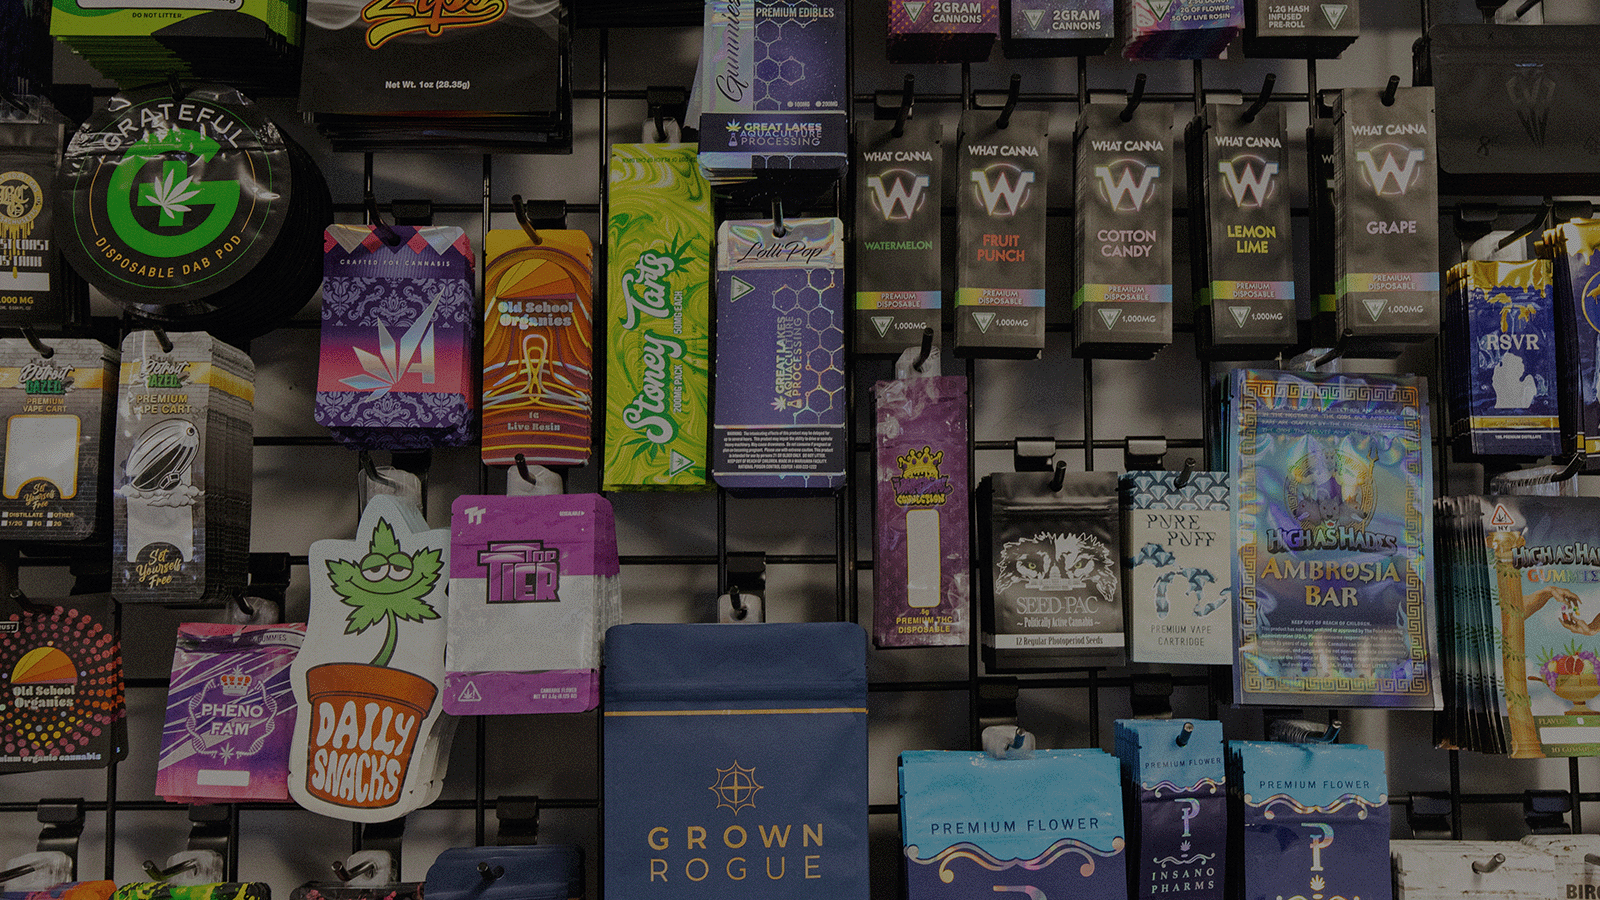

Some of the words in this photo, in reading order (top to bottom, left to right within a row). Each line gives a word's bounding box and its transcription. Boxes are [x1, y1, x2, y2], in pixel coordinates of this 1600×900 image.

[756, 7, 797, 18] PREMIUM
[798, 7, 835, 18] EDIBLES
[933, 2, 981, 13] 2GRAM
[1291, 5, 1310, 13] HASH
[932, 14, 982, 23] CANNONS
[1053, 10, 1100, 21] 2GRAM
[1268, 13, 1302, 21] INFUSED
[1052, 21, 1101, 30] CANNONS
[1268, 20, 1305, 29] PRE-ROLL
[435, 80, 471, 90] (28.35g)
[102, 103, 246, 152] GRATEFUL
[744, 122, 783, 131] GREAT
[785, 122, 822, 131] LAKES
[1352, 125, 1383, 136] WHAT
[1385, 124, 1427, 136] CANNA
[740, 130, 822, 138] AQUACULTURE
[741, 137, 821, 147] PROCESSING
[1092, 140, 1122, 151] WHAT
[1123, 140, 1164, 152] CANNA
[1215, 136, 1243, 147] WHAT
[1245, 137, 1282, 149] CANNA
[863, 152, 893, 162] WHAT
[894, 151, 933, 162] CANNA
[968, 145, 999, 156] WHAT
[1000, 146, 1039, 157] CANNA
[1227, 225, 1277, 239] LEMON
[1366, 220, 1417, 235] GRAPE
[982, 234, 1020, 248] FRUIT
[1097, 229, 1156, 243] COTTON
[864, 241, 933, 251] WATERMELON
[1101, 244, 1152, 258] CANDY
[1236, 240, 1269, 254] LIME
[95, 236, 175, 279] DISPOSABLE
[182, 257, 211, 275] DAB
[216, 234, 242, 260] POD
[737, 241, 783, 263] Lolli
[785, 240, 823, 265] Pop
[976, 249, 1025, 262] PUNCH
[339, 258, 379, 267] CRAFTED
[383, 259, 400, 267] FOR
[404, 259, 451, 267] CANNABIS
[1372, 274, 1411, 282] PREMIUM
[621, 253, 676, 329] Tarts
[1108, 285, 1145, 293] PREMIUM
[1236, 282, 1270, 290] PREMIUM
[1368, 282, 1416, 291] DISPOSABLE
[881, 292, 917, 300] PREMIUM
[982, 289, 1019, 298] PREMIUM
[1103, 292, 1150, 301] DISPOSABLE
[1233, 290, 1275, 299] DISPOSABLE
[20, 296, 34, 304] MG
[673, 291, 682, 311] EACH
[876, 300, 921, 308] DISPOSABLE
[978, 297, 1023, 305] DISPOSABLE
[498, 301, 522, 313] Old
[525, 301, 574, 313] School
[1388, 305, 1424, 314] 1,000MG
[500, 314, 572, 330] Organics
[995, 318, 1029, 327] 1,000MG
[1121, 315, 1156, 323] 1,000MG
[1251, 312, 1283, 321] 1,000MG
[673, 312, 682, 335] 50MG
[894, 322, 927, 331] 1,000MG
[776, 316, 786, 353] LAKES
[1487, 334, 1540, 351] RSVR
[784, 316, 794, 398] AQUACULTURE
[792, 317, 802, 396] PROCESSING
[673, 364, 682, 385] PACK
[775, 355, 786, 394] GREAT
[622, 331, 687, 444] Stoney
[26, 397, 64, 405] PREMIUM
[136, 394, 188, 404] PREMIUM
[673, 386, 682, 413] 200MG
[22, 405, 44, 413] VAPE
[46, 405, 67, 413] CART
[161, 404, 192, 414] CART
[507, 421, 531, 431] Live
[533, 422, 561, 431] Rosin
[1147, 514, 1201, 531] PURE
[1167, 531, 1217, 547] PUFF
[1313, 527, 1338, 550] AS
[149, 548, 169, 563] Set
[1511, 545, 1555, 569] HIGH
[1554, 544, 1575, 565] AS
[136, 561, 182, 582] Yourself
[479, 551, 560, 602] TIER
[1260, 557, 1401, 584] AMBROSIA
[148, 574, 173, 589] Free
[1304, 585, 1359, 608] BAR
[1016, 596, 1100, 615] SEED-PAC
[896, 616, 934, 625] PREMIUM
[936, 616, 953, 624] THC
[1024, 616, 1051, 629] Politically
[1068, 616, 1094, 627] Cannabis
[898, 625, 951, 634] DISPOSABLE
[1151, 625, 1187, 634] PREMIUM
[1190, 625, 1211, 634] VAPE
[1016, 637, 1022, 645] 12
[1023, 637, 1047, 647] Regular
[1048, 636, 1085, 647] Photoperiod
[1086, 636, 1103, 645] Seeds
[1158, 637, 1205, 646] CARTRIDGE
[12, 686, 33, 696] Old
[35, 685, 75, 695] School
[14, 695, 74, 710] Organics
[201, 703, 263, 718] PHENO
[210, 722, 250, 736] FAM
[315, 700, 415, 756] DAILY
[58, 751, 101, 761] cannabis
[1145, 760, 1185, 769] PREMIUM
[1188, 757, 1222, 766] FLOWER
[311, 747, 400, 803] SNACKS
[1259, 780, 1317, 789] PREMIUM
[1323, 780, 1370, 789] FLOWER
[931, 820, 1016, 835] PREMIUM
[1027, 817, 1099, 831] FLOWER
[647, 823, 823, 850] GROWN
[650, 854, 821, 882] ROGUE
[1151, 867, 1215, 881] INSANO
[1151, 880, 1215, 893] PHARMS
[1566, 884, 1600, 899] BIR
